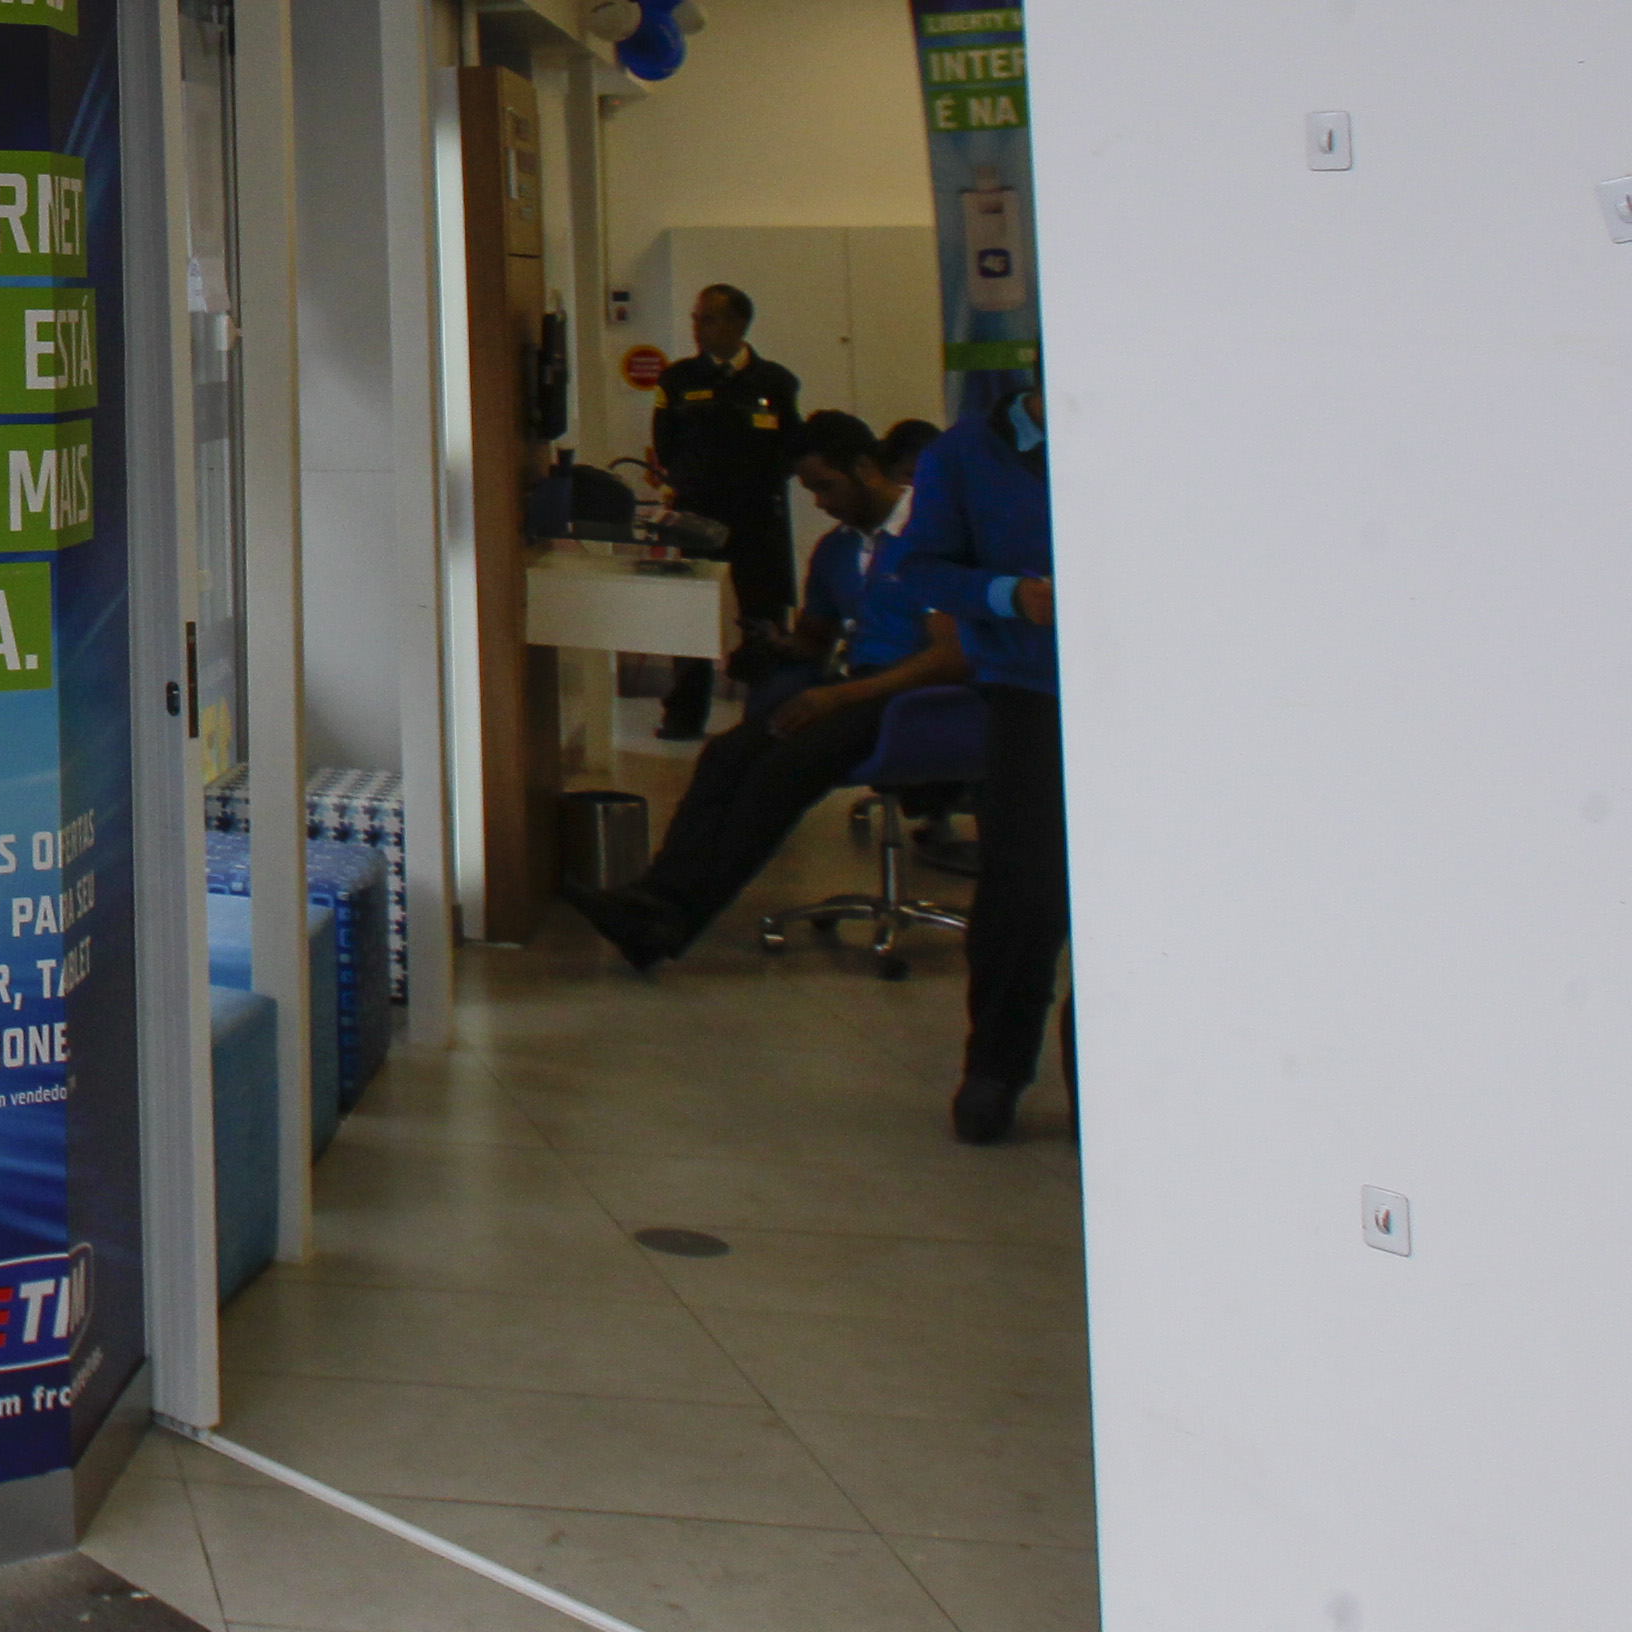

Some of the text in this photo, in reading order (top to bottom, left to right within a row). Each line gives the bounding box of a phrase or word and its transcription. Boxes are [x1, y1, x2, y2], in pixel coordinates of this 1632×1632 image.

[967, 94, 1020, 128] NA
[24, 294, 93, 391] ESTÁ
[8, 443, 91, 532] MAIS
